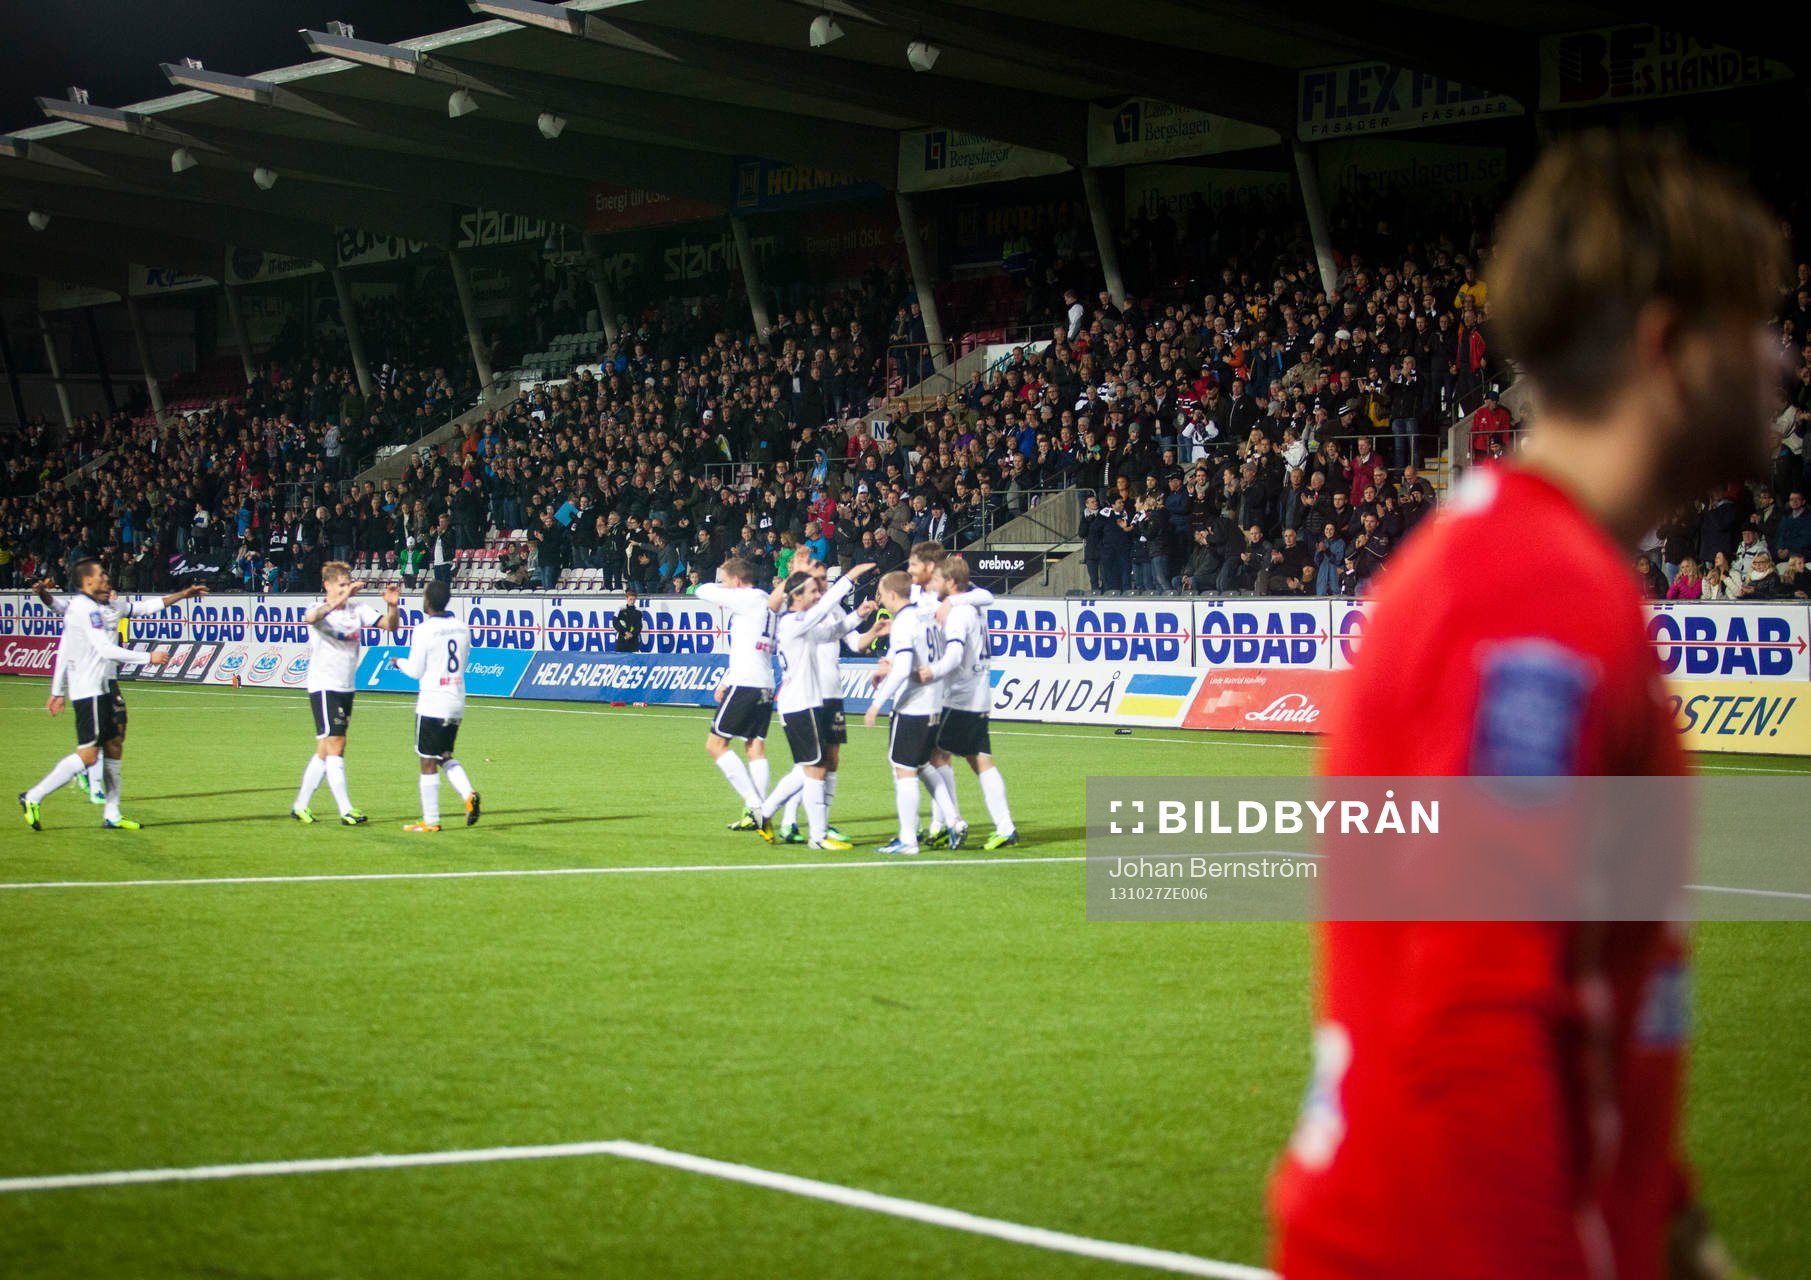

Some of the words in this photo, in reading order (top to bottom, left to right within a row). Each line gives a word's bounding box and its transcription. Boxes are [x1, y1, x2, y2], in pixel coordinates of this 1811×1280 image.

[1302, 65, 1400, 122] FLEX
[1144, 118, 1210, 143] Bergslagen
[1311, 118, 1390, 135] FASADER
[1422, 102, 1507, 122] FASADER
[950, 147, 1009, 170] Bergslagen
[595, 189, 628, 213] Energi
[874, 422, 884, 439] N
[978, 554, 1025, 571] orebro.se
[192, 595, 245, 642] ÖBAB
[254, 595, 310, 643] ÖBAB
[468, 596, 536, 650] ÖBAB
[1075, 600, 1180, 662] ÖBAB
[1201, 600, 1317, 664] ÖBAB
[0, 641, 58, 669] Scandic
[1645, 603, 1794, 676] ÖBAB
[447, 639, 460, 674] 8
[471, 662, 505, 677] Recycling
[531, 662, 573, 686] HELA
[570, 663, 645, 690] SVERIGES
[642, 665, 730, 692] FOTBOLLS
[994, 671, 1122, 714] SANDÅ
[1244, 693, 1321, 723] Linde
